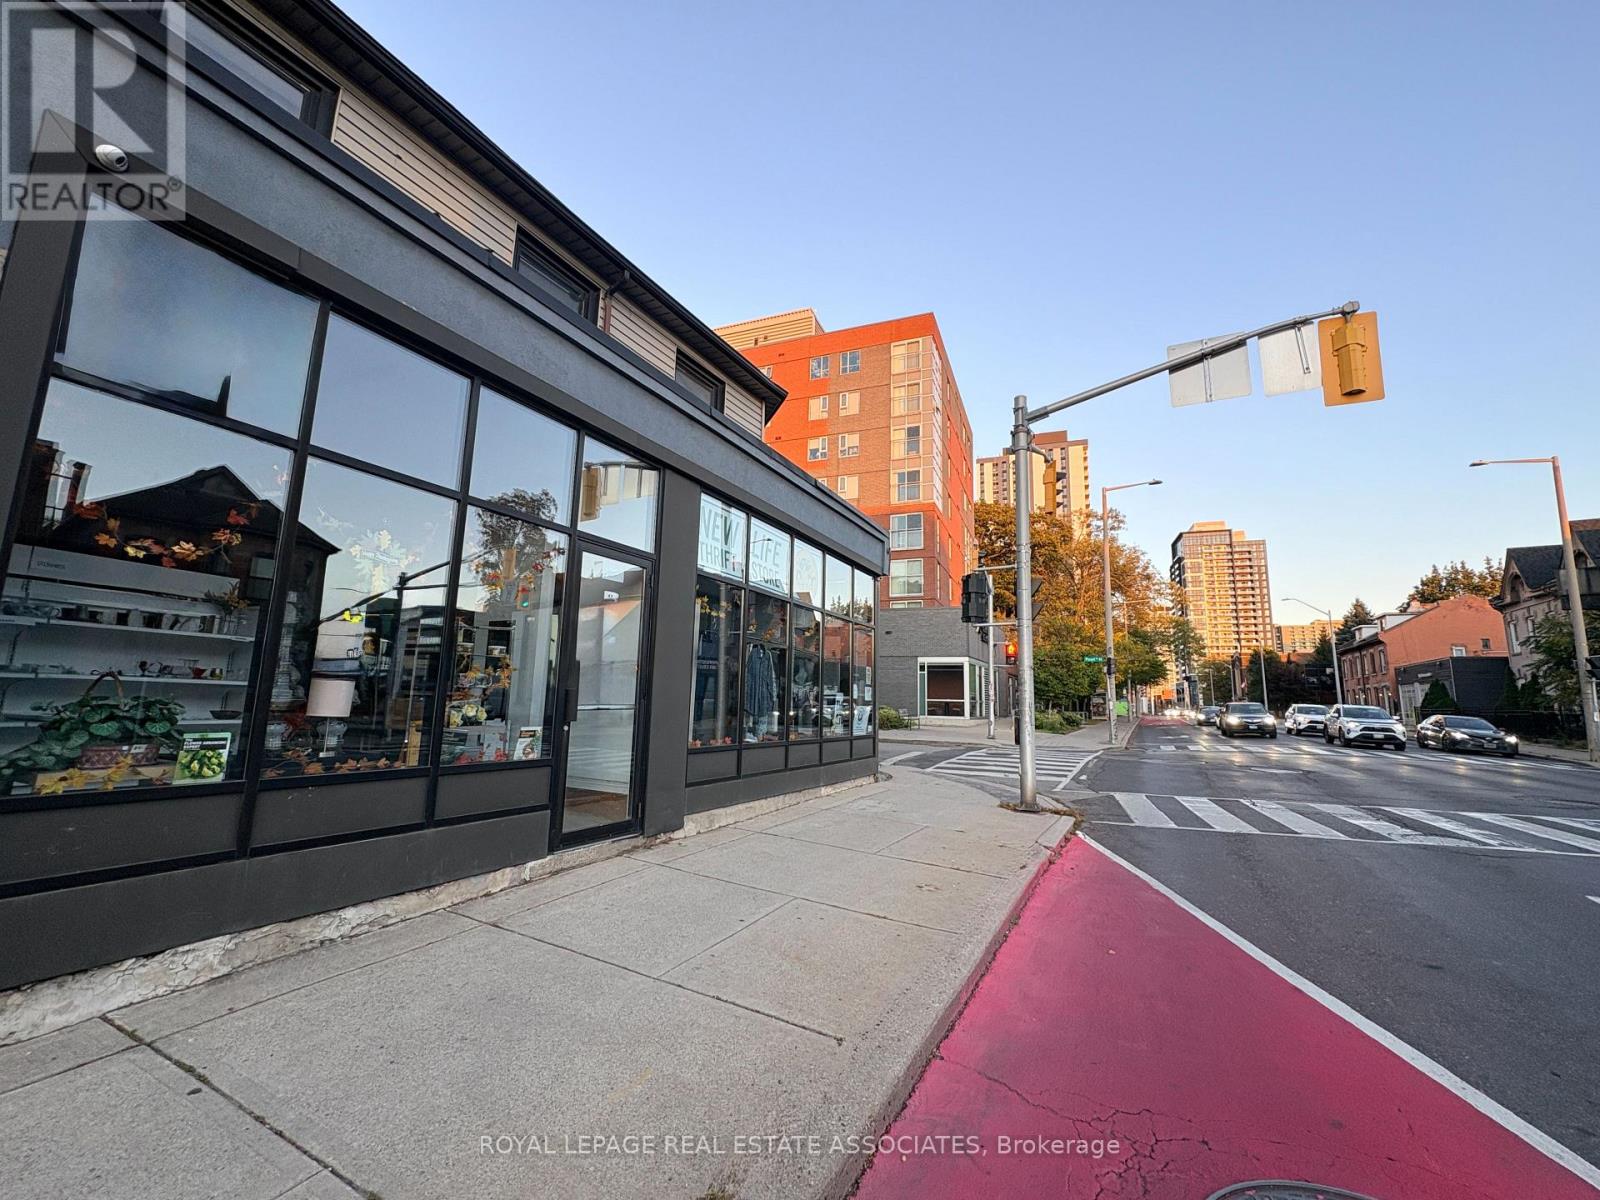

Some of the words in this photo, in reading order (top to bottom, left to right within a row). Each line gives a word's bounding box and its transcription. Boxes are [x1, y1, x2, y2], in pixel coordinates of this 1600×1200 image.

[699, 540, 738, 573] THRIFT
[750, 558, 781, 589] STORE
[751, 530, 781, 568] LIFE
